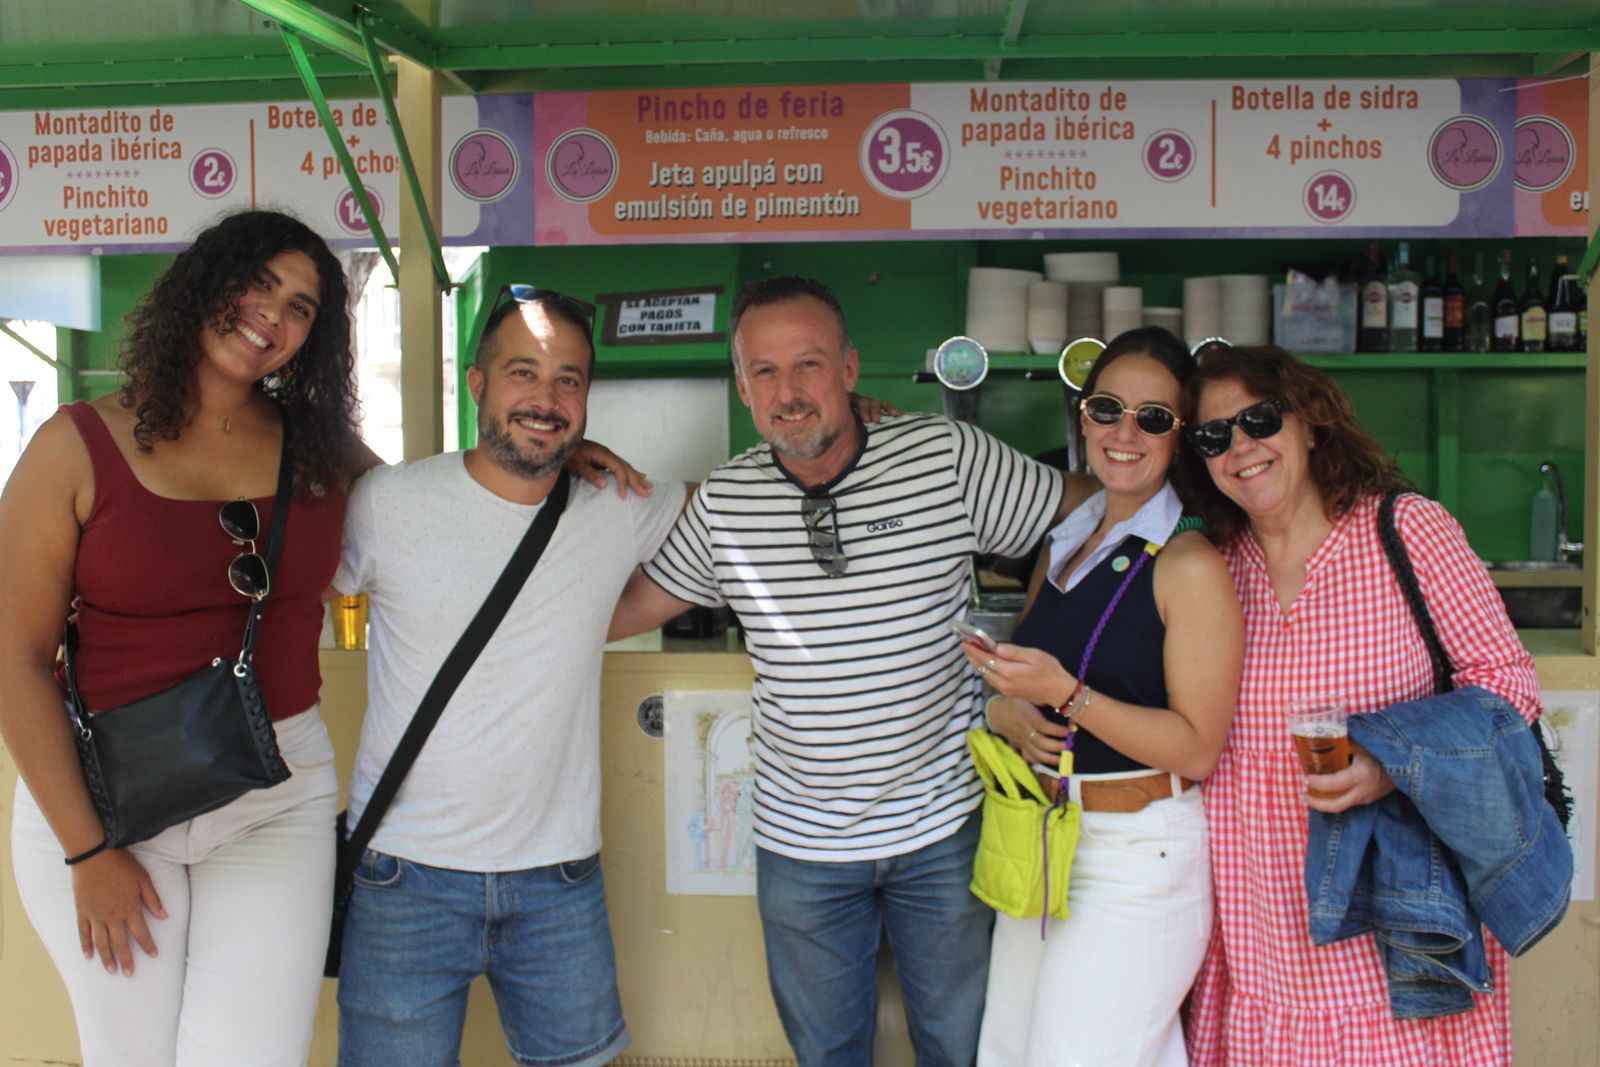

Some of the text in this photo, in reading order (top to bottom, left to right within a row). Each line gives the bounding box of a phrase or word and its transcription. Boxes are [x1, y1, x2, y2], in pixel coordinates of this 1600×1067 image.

[637, 91, 844, 122] Pincho de feria
[970, 86, 1127, 113] Montadito de
[1232, 84, 1419, 110] Botella de sidra
[35, 108, 174, 135] Montadito de
[268, 104, 343, 129] Botea
[352, 103, 377, 127] de
[645, 126, 829, 143] Bebida: Caña, agua o refresco
[961, 115, 1135, 147] papada ibérica
[28, 136, 182, 168] papada ibérica
[301, 151, 314, 175] 4
[1159, 138, 1183, 170] 2€
[1266, 134, 1382, 165] 4 pinchos
[204, 157, 226, 187] 2€
[649, 158, 823, 190] Jeta apulpá con
[1000, 166, 1097, 191] Pinchito
[63, 184, 149, 209] Pinchito
[614, 190, 860, 223] emulsión de pimentón
[1314, 184, 1346, 211] 14€
[978, 196, 1119, 225] vegetariano
[44, 213, 168, 241] vegetariano
[619, 320, 702, 335] CON TARJETA
[640, 309, 683, 321] PAGOS
